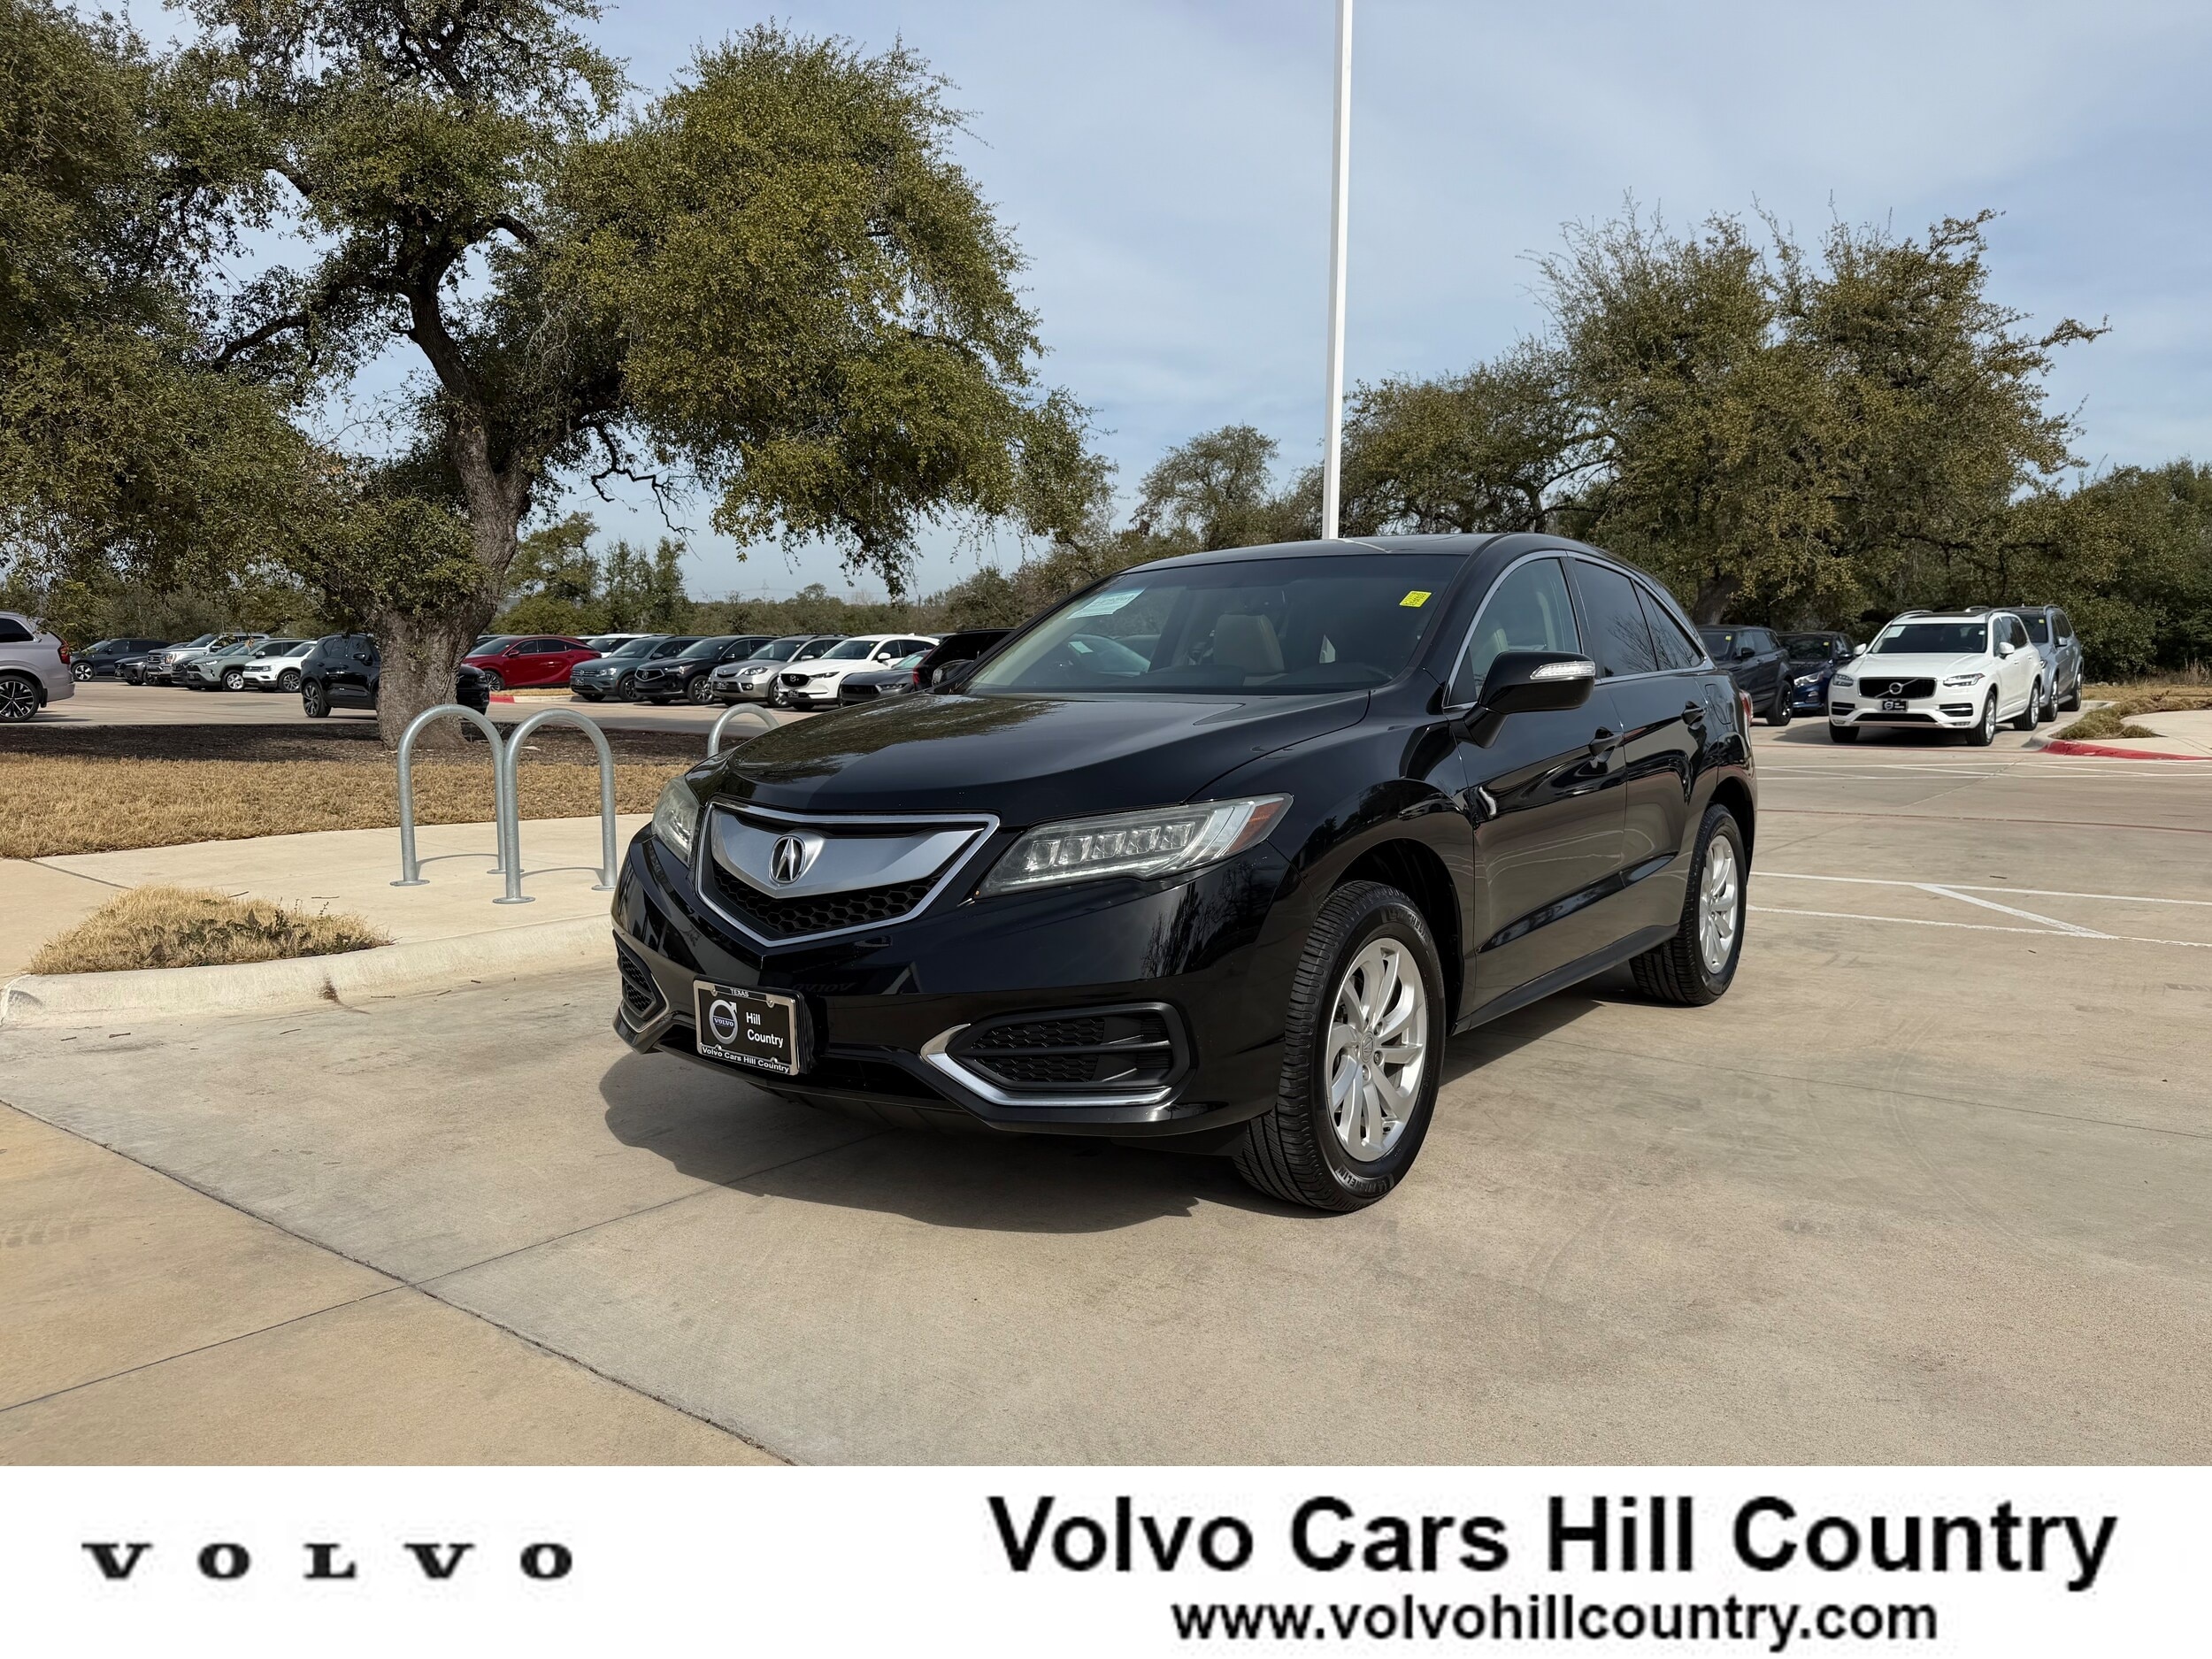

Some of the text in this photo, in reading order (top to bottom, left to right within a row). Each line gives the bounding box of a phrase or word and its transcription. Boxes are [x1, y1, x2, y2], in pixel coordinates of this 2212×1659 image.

[730, 988, 749, 998] TEXAS
[713, 1018, 734, 1027] VOLVO
[746, 1011, 761, 1025] Hill
[747, 1029, 783, 1048] Country
[702, 1046, 789, 1073] Volvo Cars Hill Country
